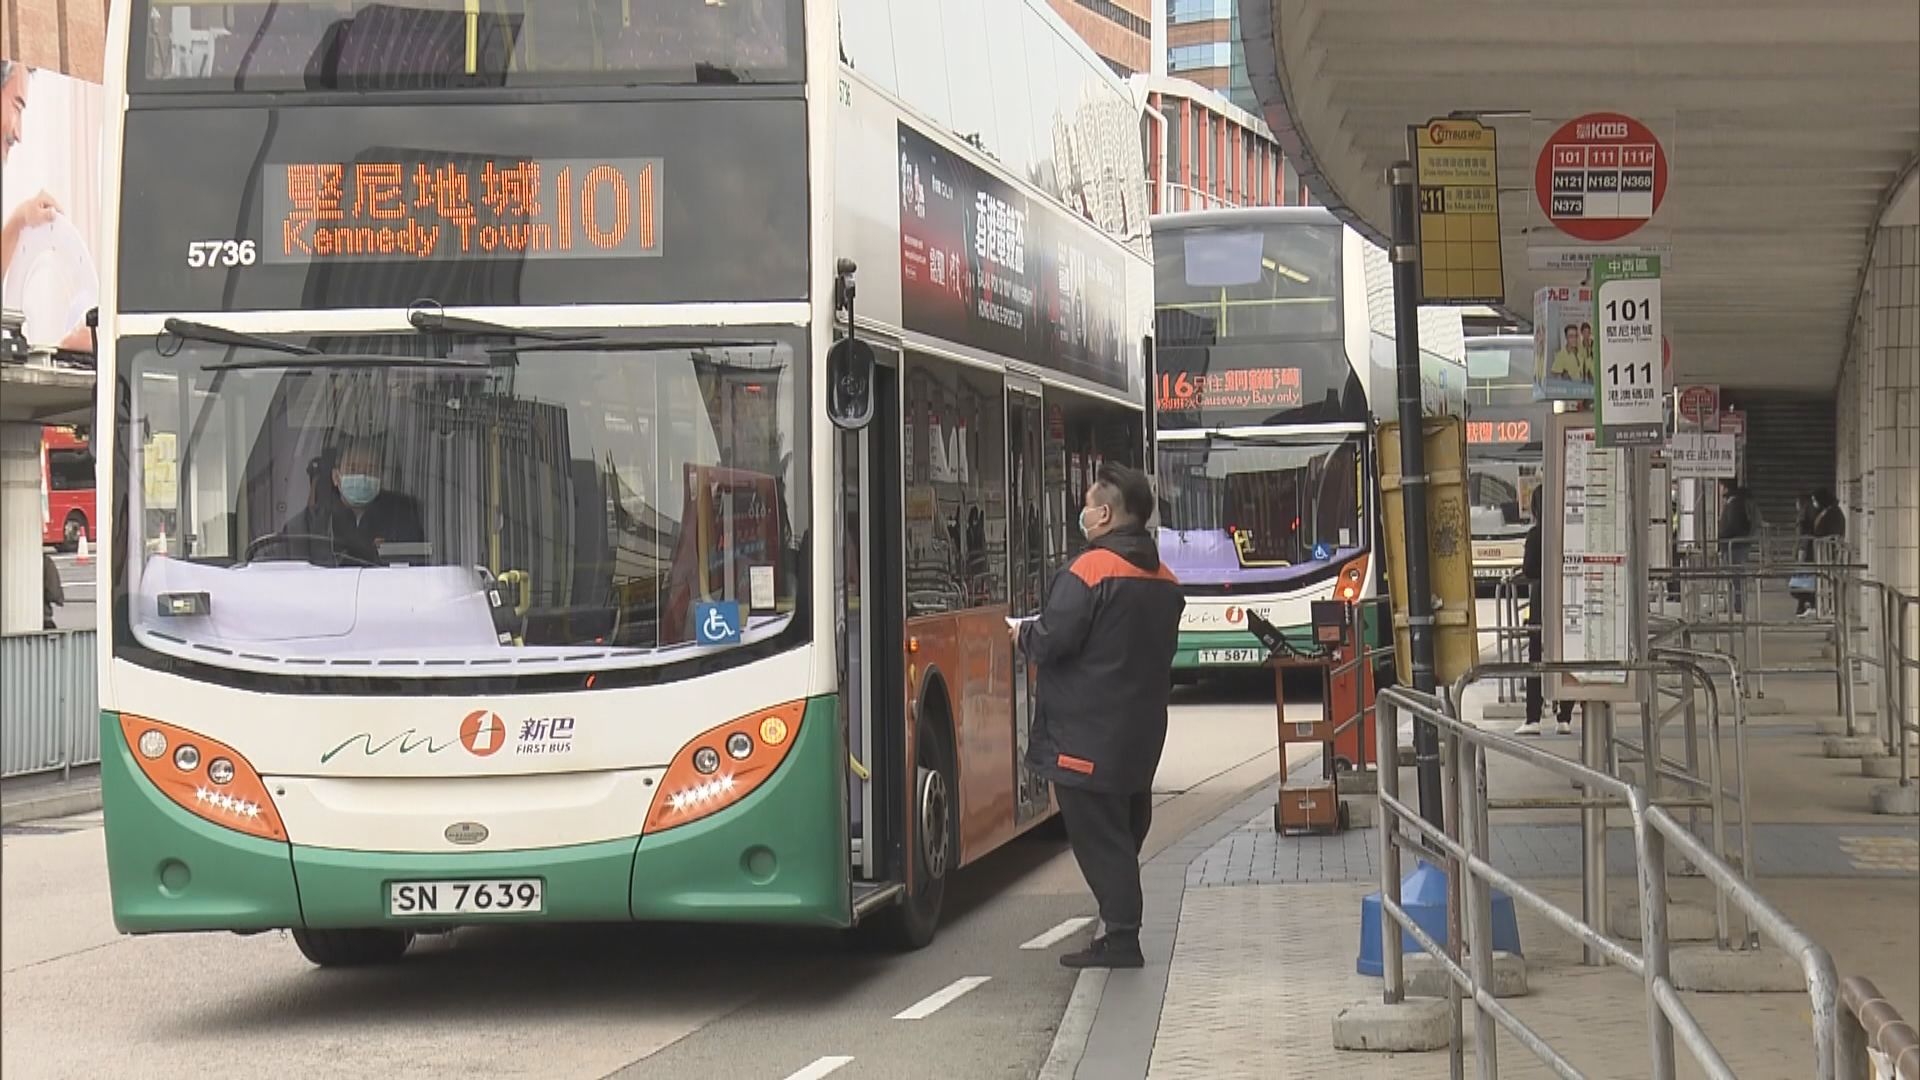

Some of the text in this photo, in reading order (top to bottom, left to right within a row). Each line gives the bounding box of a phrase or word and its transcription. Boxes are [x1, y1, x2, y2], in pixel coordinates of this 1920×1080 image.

[1592, 122, 1628, 138] KMB
[1559, 149, 1653, 164] 101 111 111P
[287, 161, 542, 220] 堅尼地城
[1554, 176, 1651, 188] N121 N182 N368
[557, 162, 656, 250] 101
[1554, 199, 1582, 212] N373
[283, 217, 552, 258] Kennedy Town
[187, 239, 256, 268] 5736
[1608, 258, 1649, 273] 中西區
[1548, 288, 1569, 301] 九巴
[1606, 298, 1650, 321] 101
[1608, 362, 1651, 385] 111
[1195, 391, 1251, 407] Causeway
[1251, 389, 1275, 405] Bay
[1277, 388, 1300, 404] only
[1497, 421, 1529, 441] 102
[1204, 650, 1253, 662] TY 5871
[519, 717, 575, 742] 新巴
[516, 742, 572, 755] FIRST BUS
[398, 884, 535, 911] SN 7639
